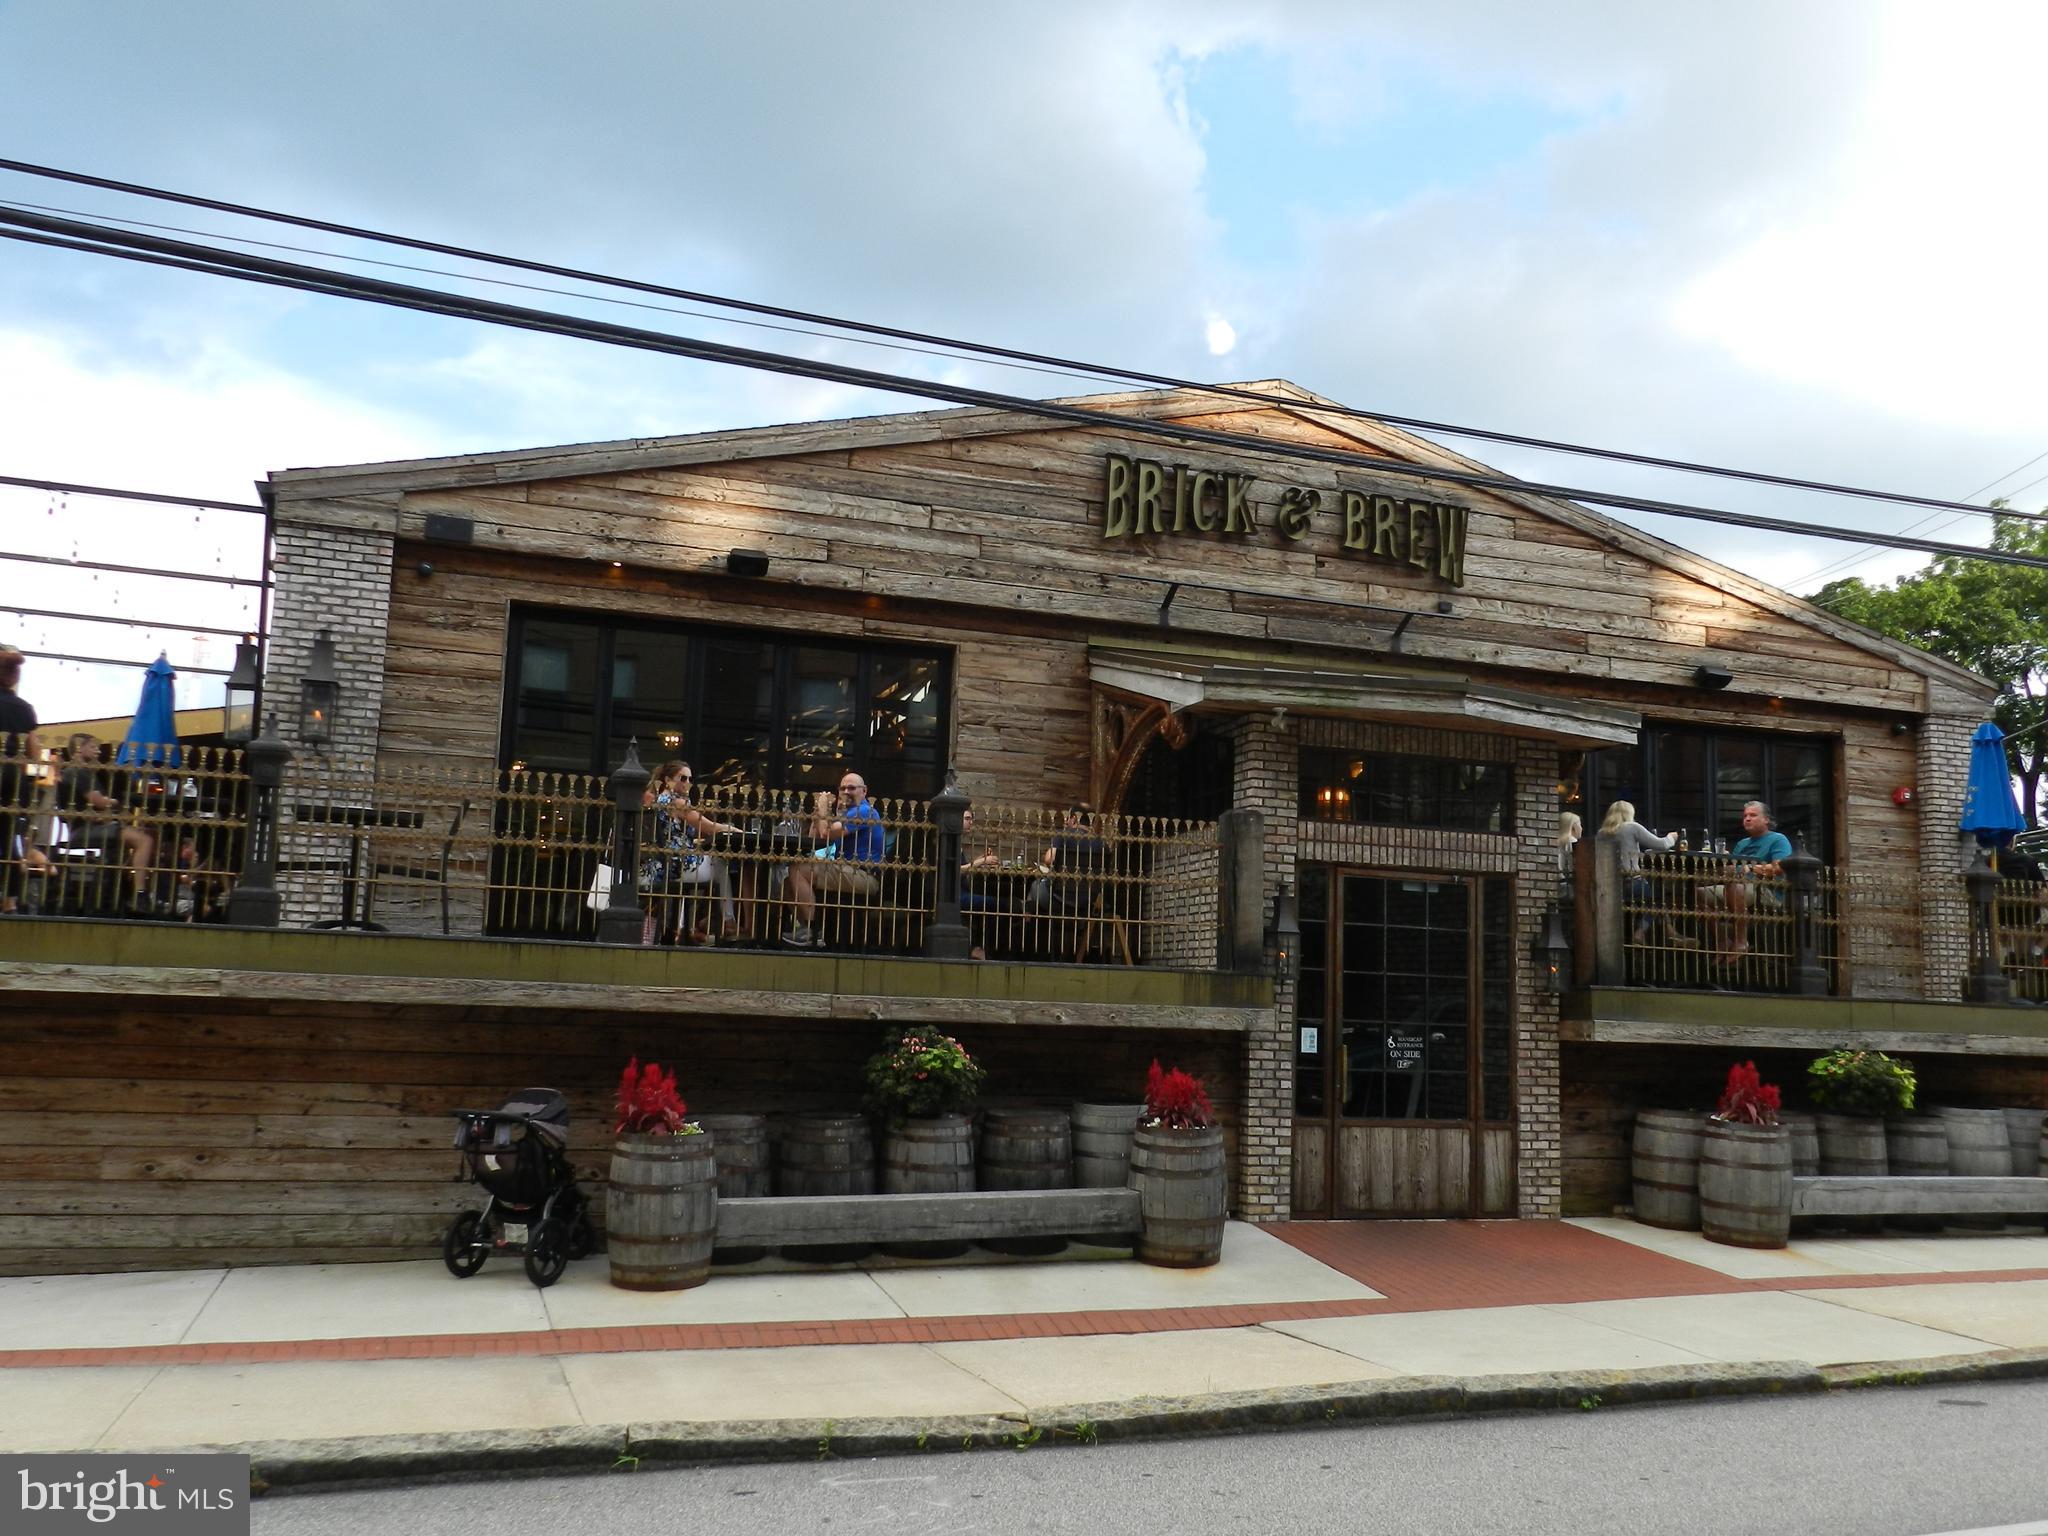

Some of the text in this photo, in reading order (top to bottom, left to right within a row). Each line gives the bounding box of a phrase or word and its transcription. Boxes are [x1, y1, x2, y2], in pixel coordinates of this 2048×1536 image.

[1104, 452, 1471, 588] BRICK & BREW
[1390, 1050, 1421, 1058] ON SIDE
